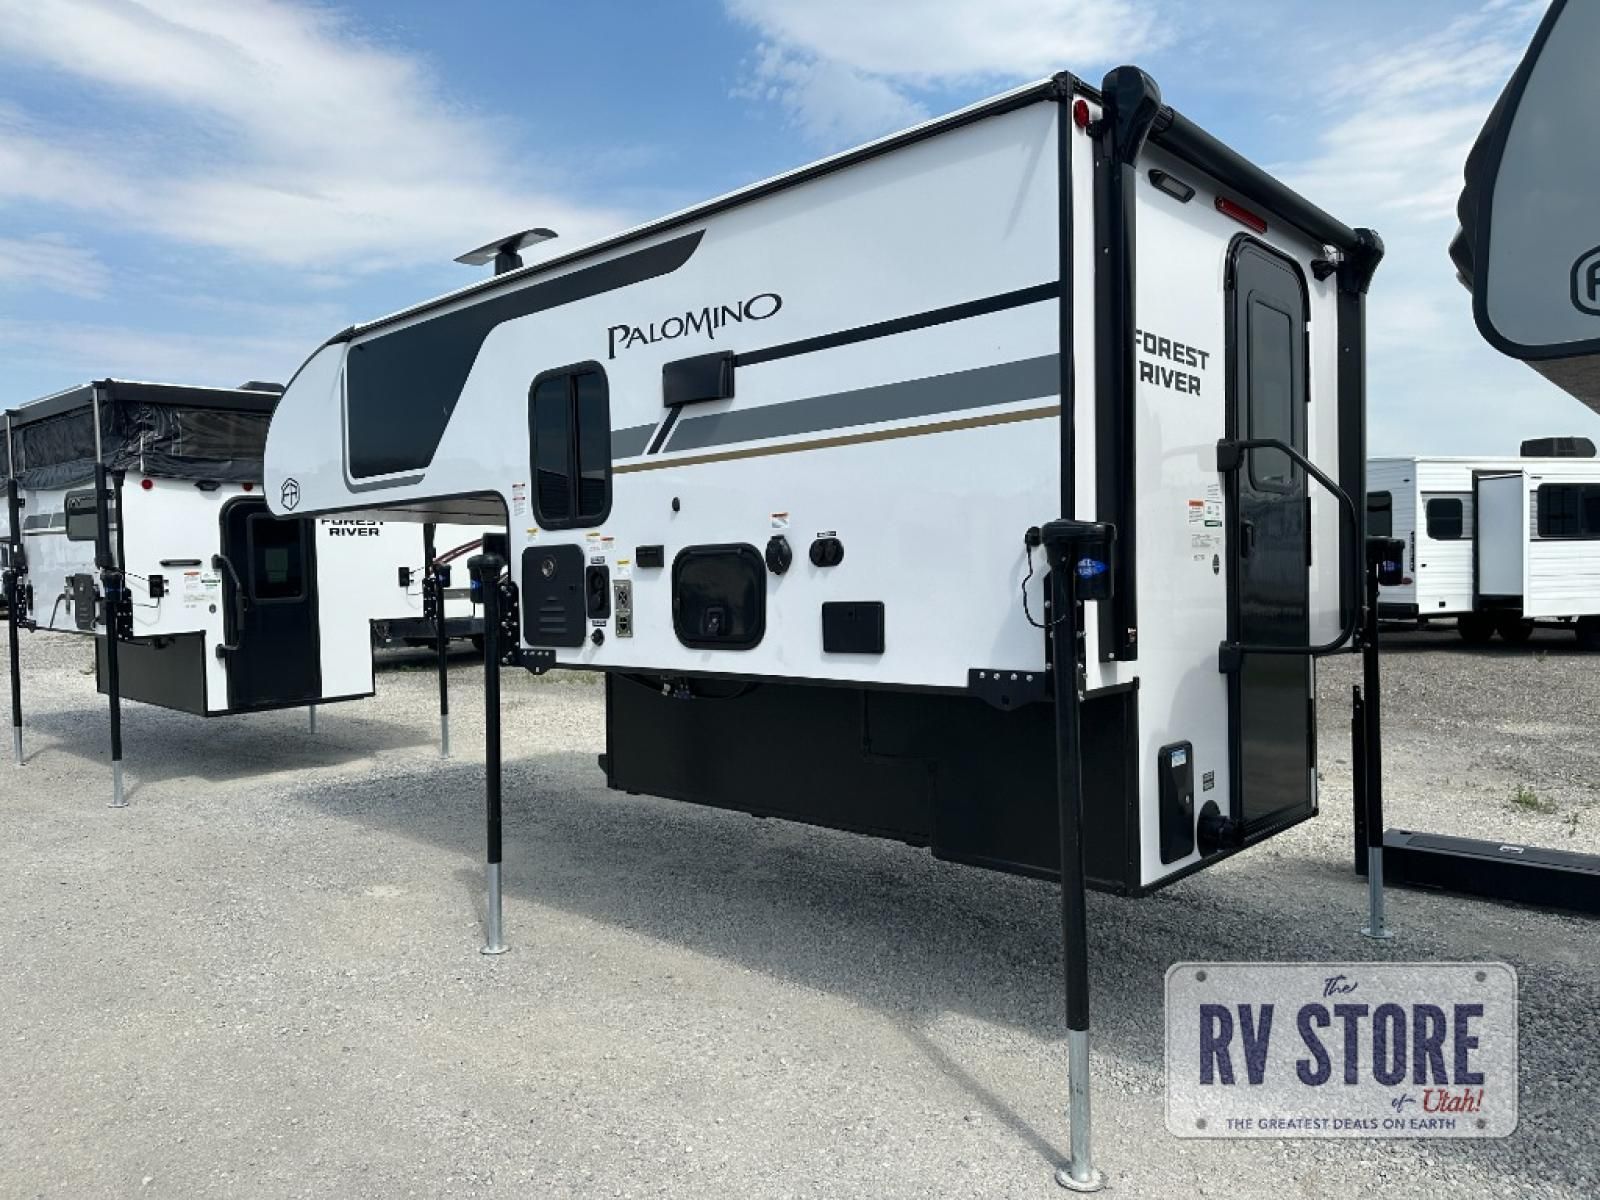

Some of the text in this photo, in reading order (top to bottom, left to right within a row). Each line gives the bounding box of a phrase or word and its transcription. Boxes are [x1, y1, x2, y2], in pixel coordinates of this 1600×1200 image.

[607, 293, 783, 360] PALOMINO
[1139, 360, 1201, 397] RIVER
[328, 527, 380, 537] RIVER
